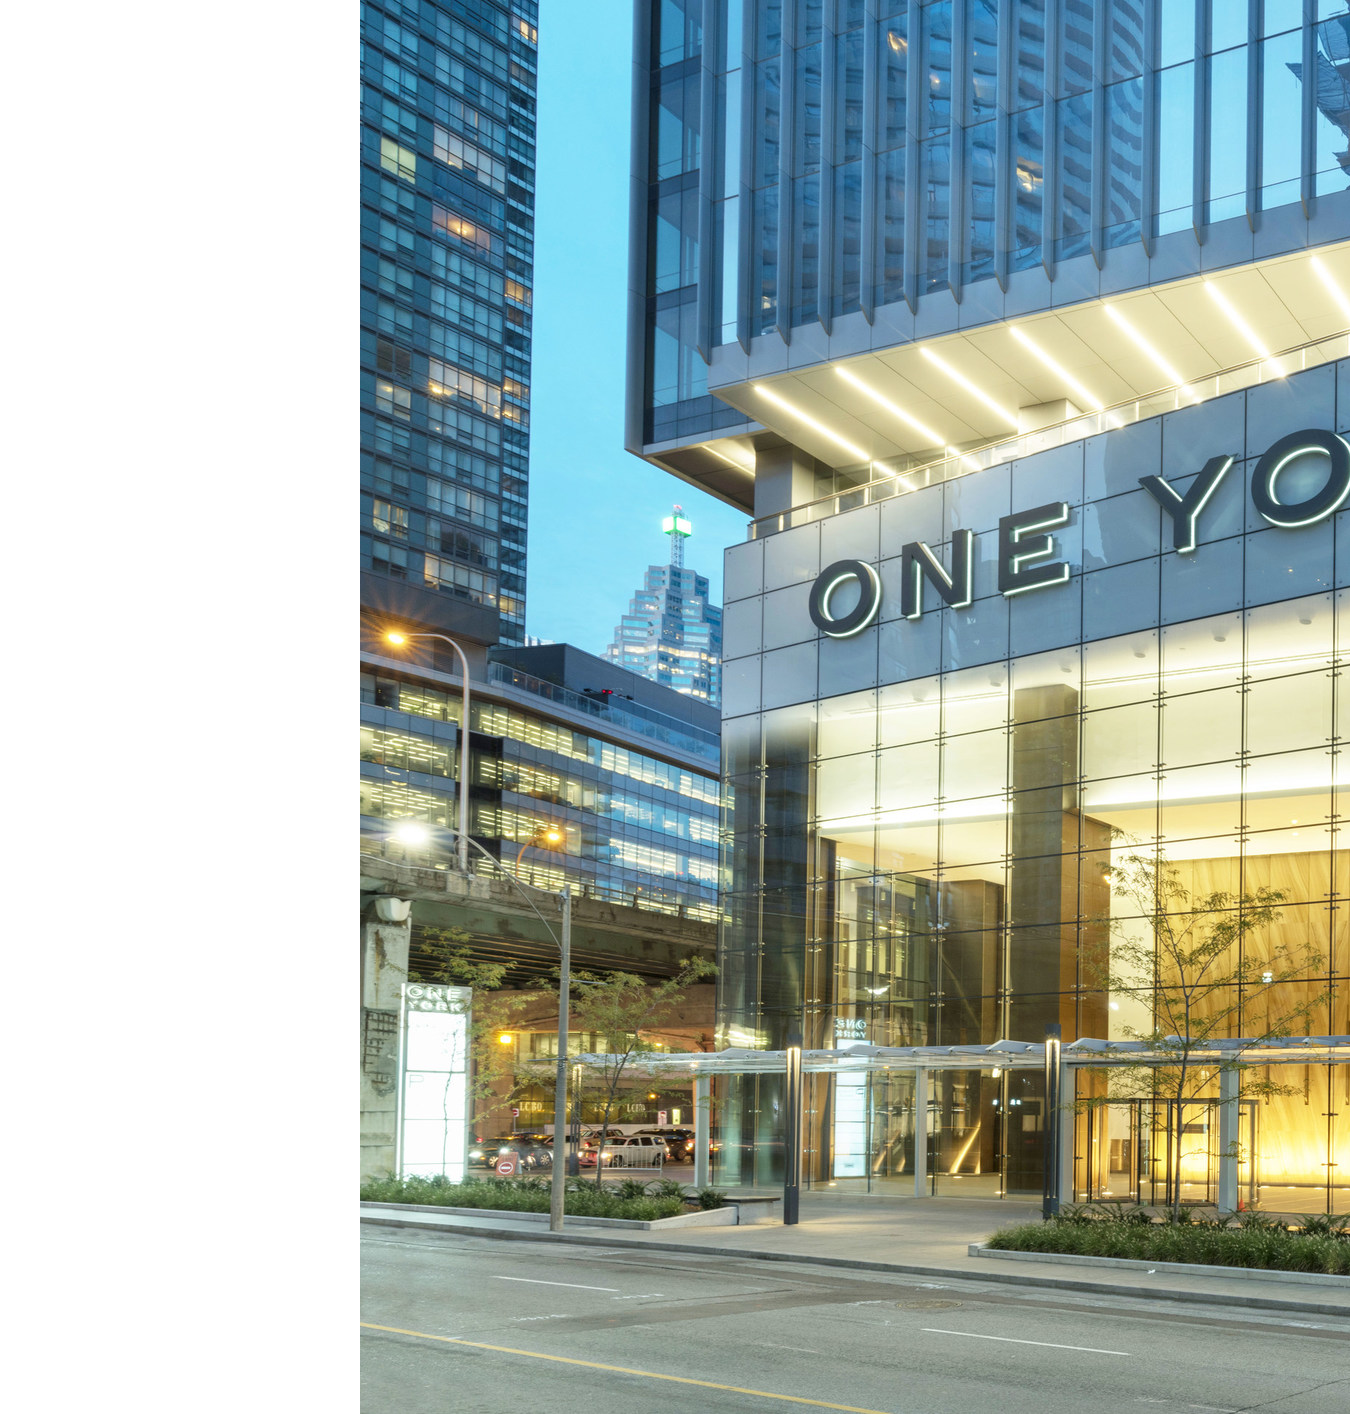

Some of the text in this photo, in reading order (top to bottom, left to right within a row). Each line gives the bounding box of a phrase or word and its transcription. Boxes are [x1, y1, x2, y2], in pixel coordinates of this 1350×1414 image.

[809, 502, 1070, 638] ONE
[407, 985, 461, 1001] ONE
[408, 1000, 465, 1012] YORK
[519, 1101, 543, 1112] LCBO
